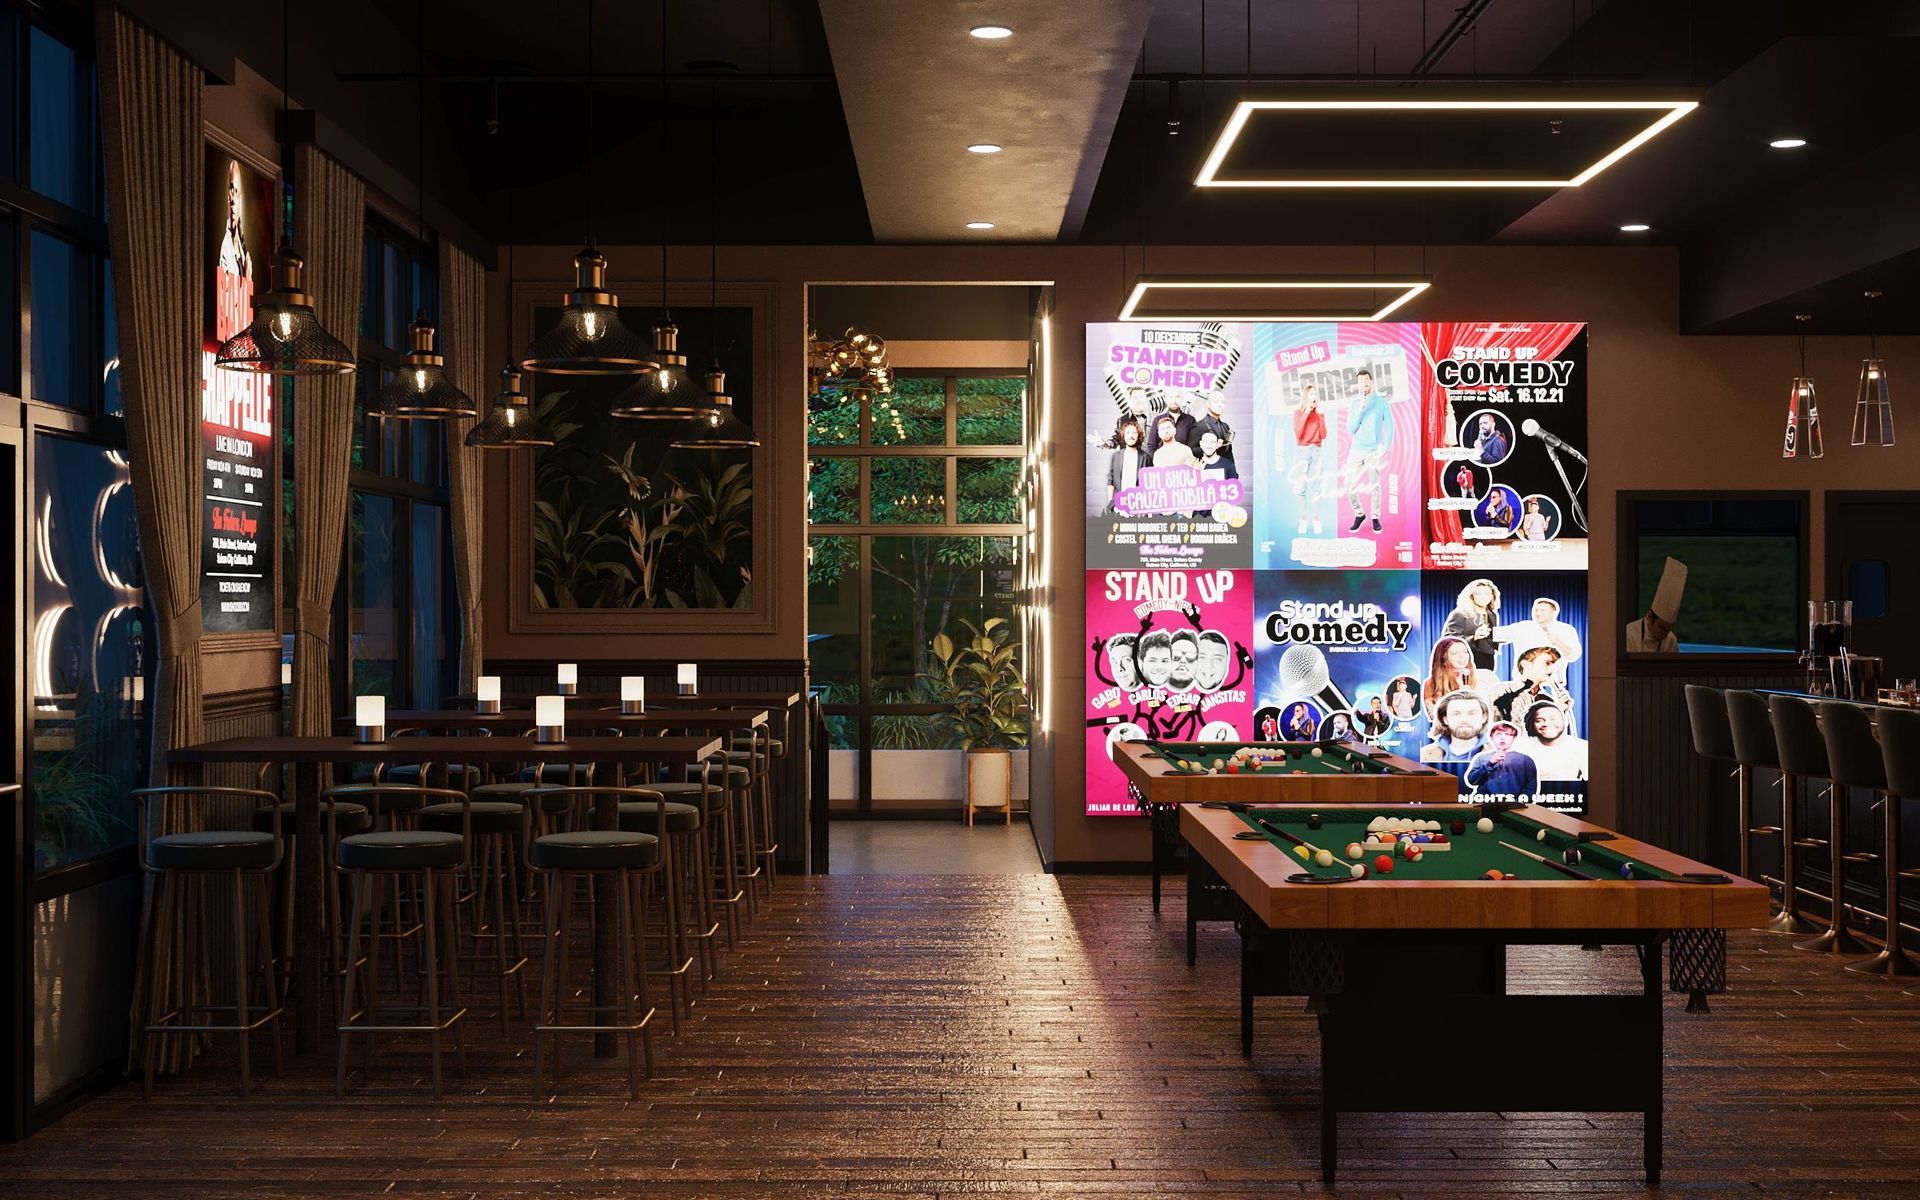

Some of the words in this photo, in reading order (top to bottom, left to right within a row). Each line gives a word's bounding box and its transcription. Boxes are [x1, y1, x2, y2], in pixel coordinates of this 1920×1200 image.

[1143, 330, 1154, 342] 10
[1154, 331, 1201, 345] DECEMBRIE
[1110, 345, 1227, 370] STAND-UP
[1280, 347, 1310, 368] Stand
[1311, 344, 1325, 360] Up
[1453, 346, 1511, 361] STAND
[1515, 346, 1539, 361] UP
[1120, 366, 1217, 390] COMEDY
[1436, 360, 1575, 387] COMEDY
[1488, 387, 1514, 403] Sat.
[1516, 388, 1564, 403] 16.12.21
[1164, 469, 1197, 488] SHOW
[1219, 483, 1239, 500] #3
[1114, 534, 1137, 544] COSTEL
[1105, 571, 1188, 602] STAND
[1195, 570, 1234, 604] UP
[1279, 600, 1344, 619] Stand
[1349, 602, 1377, 622] up
[1265, 612, 1412, 651] Comedy
[1091, 686, 1121, 710] GABO
[1128, 687, 1168, 706] CARLOS
[1166, 691, 1202, 708] EDGAR
[1200, 689, 1247, 713] JANSITAS
[1112, 803, 1121, 812] DE
[1122, 803, 1136, 812] LOS
[1457, 793, 1516, 804] NIGHTS
[1517, 793, 1529, 803] A
[1531, 793, 1575, 803] WEEK
[1577, 793, 1584, 803] !
